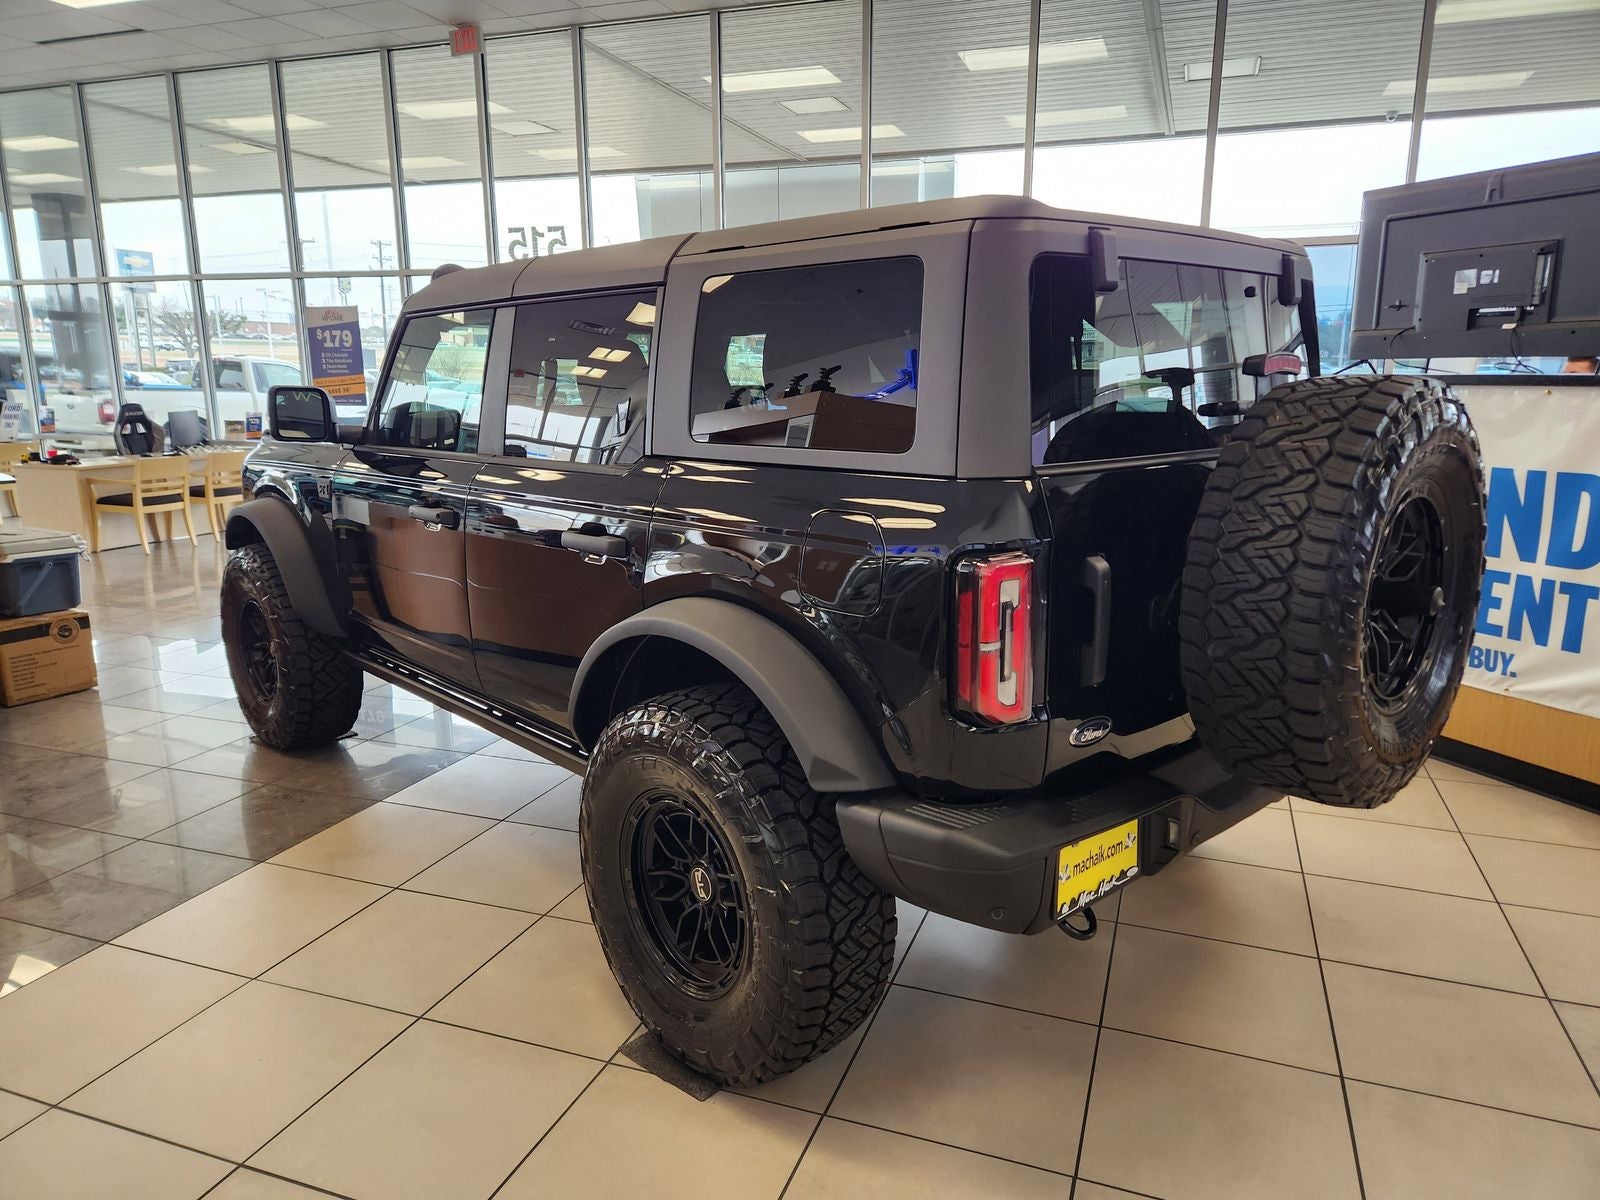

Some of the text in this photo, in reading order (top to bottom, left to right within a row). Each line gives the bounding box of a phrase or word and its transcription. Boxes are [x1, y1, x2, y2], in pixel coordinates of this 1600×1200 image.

[316, 328, 352, 348] $179
[1468, 646, 1517, 677] BUY.
[1080, 726, 1104, 742] Ford
[1072, 841, 1123, 877] machaik.com
